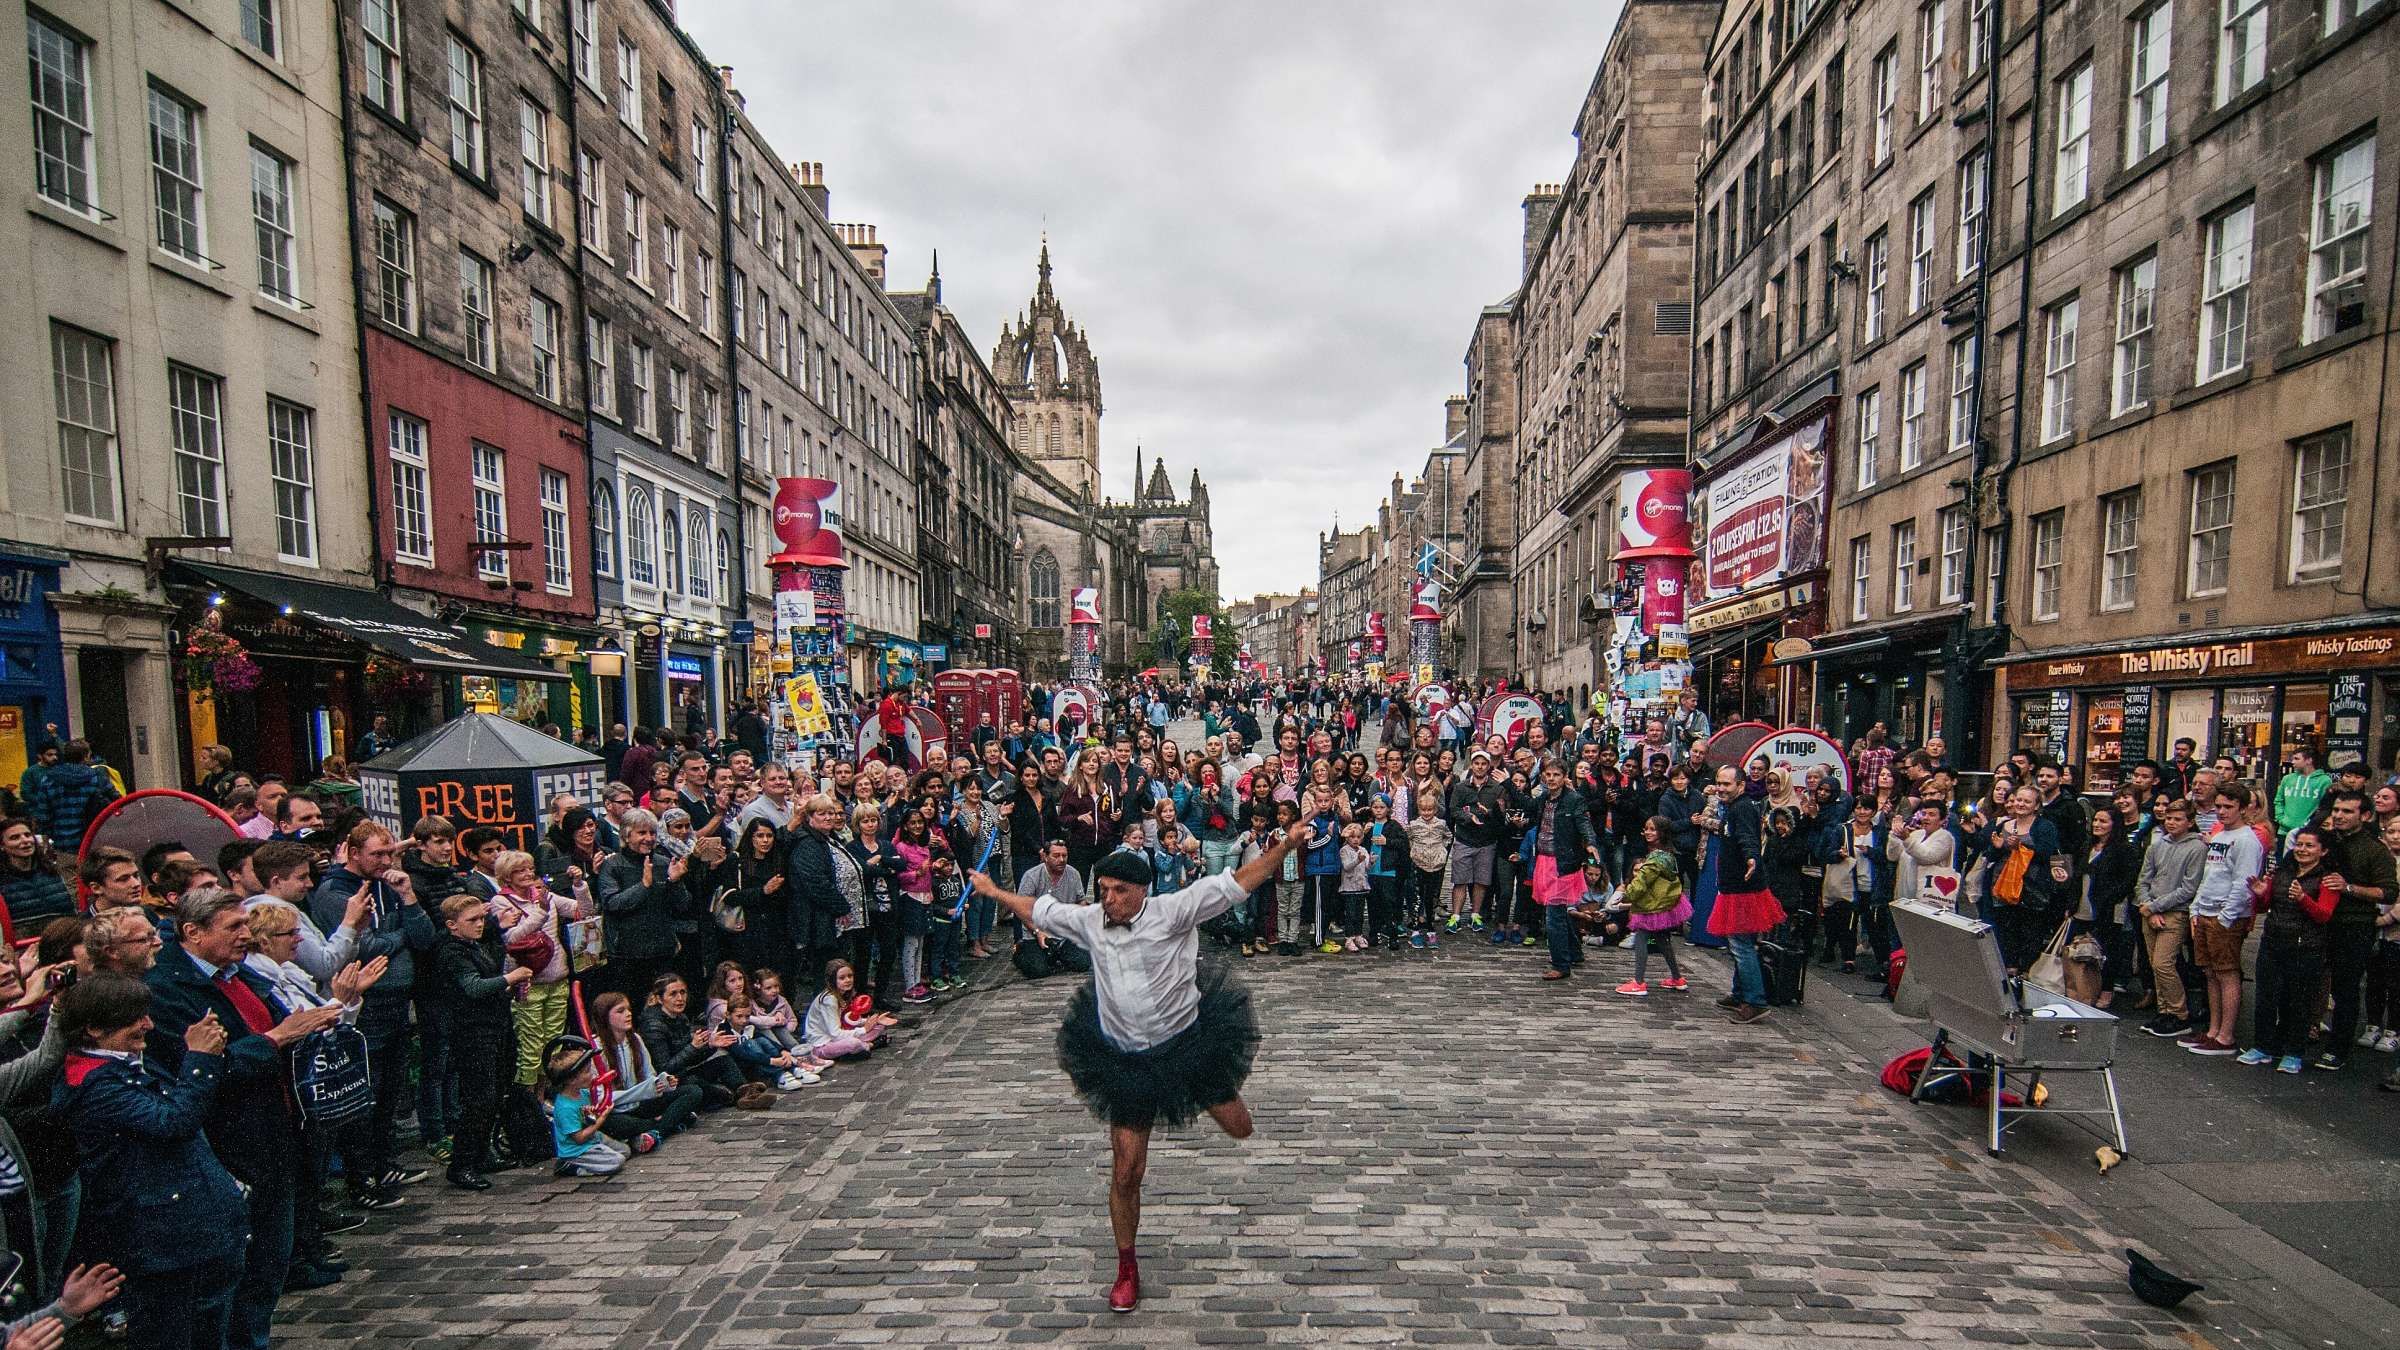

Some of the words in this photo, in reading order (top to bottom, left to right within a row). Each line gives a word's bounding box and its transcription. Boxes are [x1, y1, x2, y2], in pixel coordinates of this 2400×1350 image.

[1748, 462, 1778, 488] STATION
[1661, 503, 1684, 512] money
[790, 512, 814, 520] money
[1741, 520, 1756, 545] FOR
[1757, 507, 1782, 538] £12.95
[1758, 541, 1777, 556] FRIDAY
[1694, 616, 1706, 629] THE
[1661, 631, 1674, 639] THE
[2306, 639, 2346, 657] Whisky
[2345, 636, 2393, 654] Tastings
[2119, 652, 2149, 674] The
[2149, 647, 2211, 675] Whisky
[2211, 642, 2254, 668] Trail
[2048, 665, 2063, 676] Rare
[2062, 662, 2085, 677] Whisky
[2338, 675, 2360, 684] THE
[2334, 682, 2366, 700] LOST
[569, 680, 582, 728] WAY
[1509, 699, 1529, 709] fringe
[2126, 694, 2149, 704] SCOTCH
[2124, 706, 2149, 716] WHISKY
[1775, 739, 1817, 757] fringe
[361, 776, 400, 813] FREE
[538, 769, 607, 810] FREE
[416, 781, 516, 824] FREE
[1924, 875, 1934, 888] I
